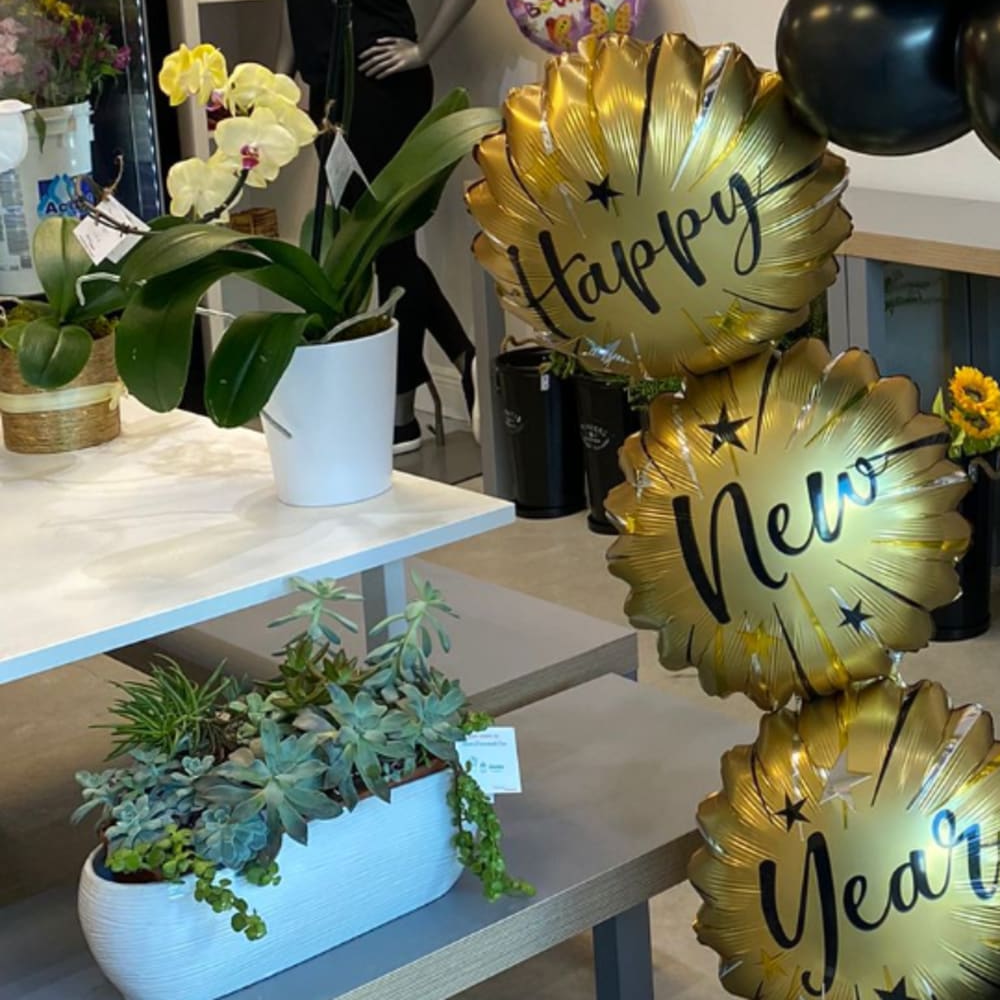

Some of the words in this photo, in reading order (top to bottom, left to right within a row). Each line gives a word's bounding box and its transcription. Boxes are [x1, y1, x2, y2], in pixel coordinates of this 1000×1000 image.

[507, 171, 763, 340] Happy
[671, 456, 878, 625] New
[759, 808, 1000, 998] Year
